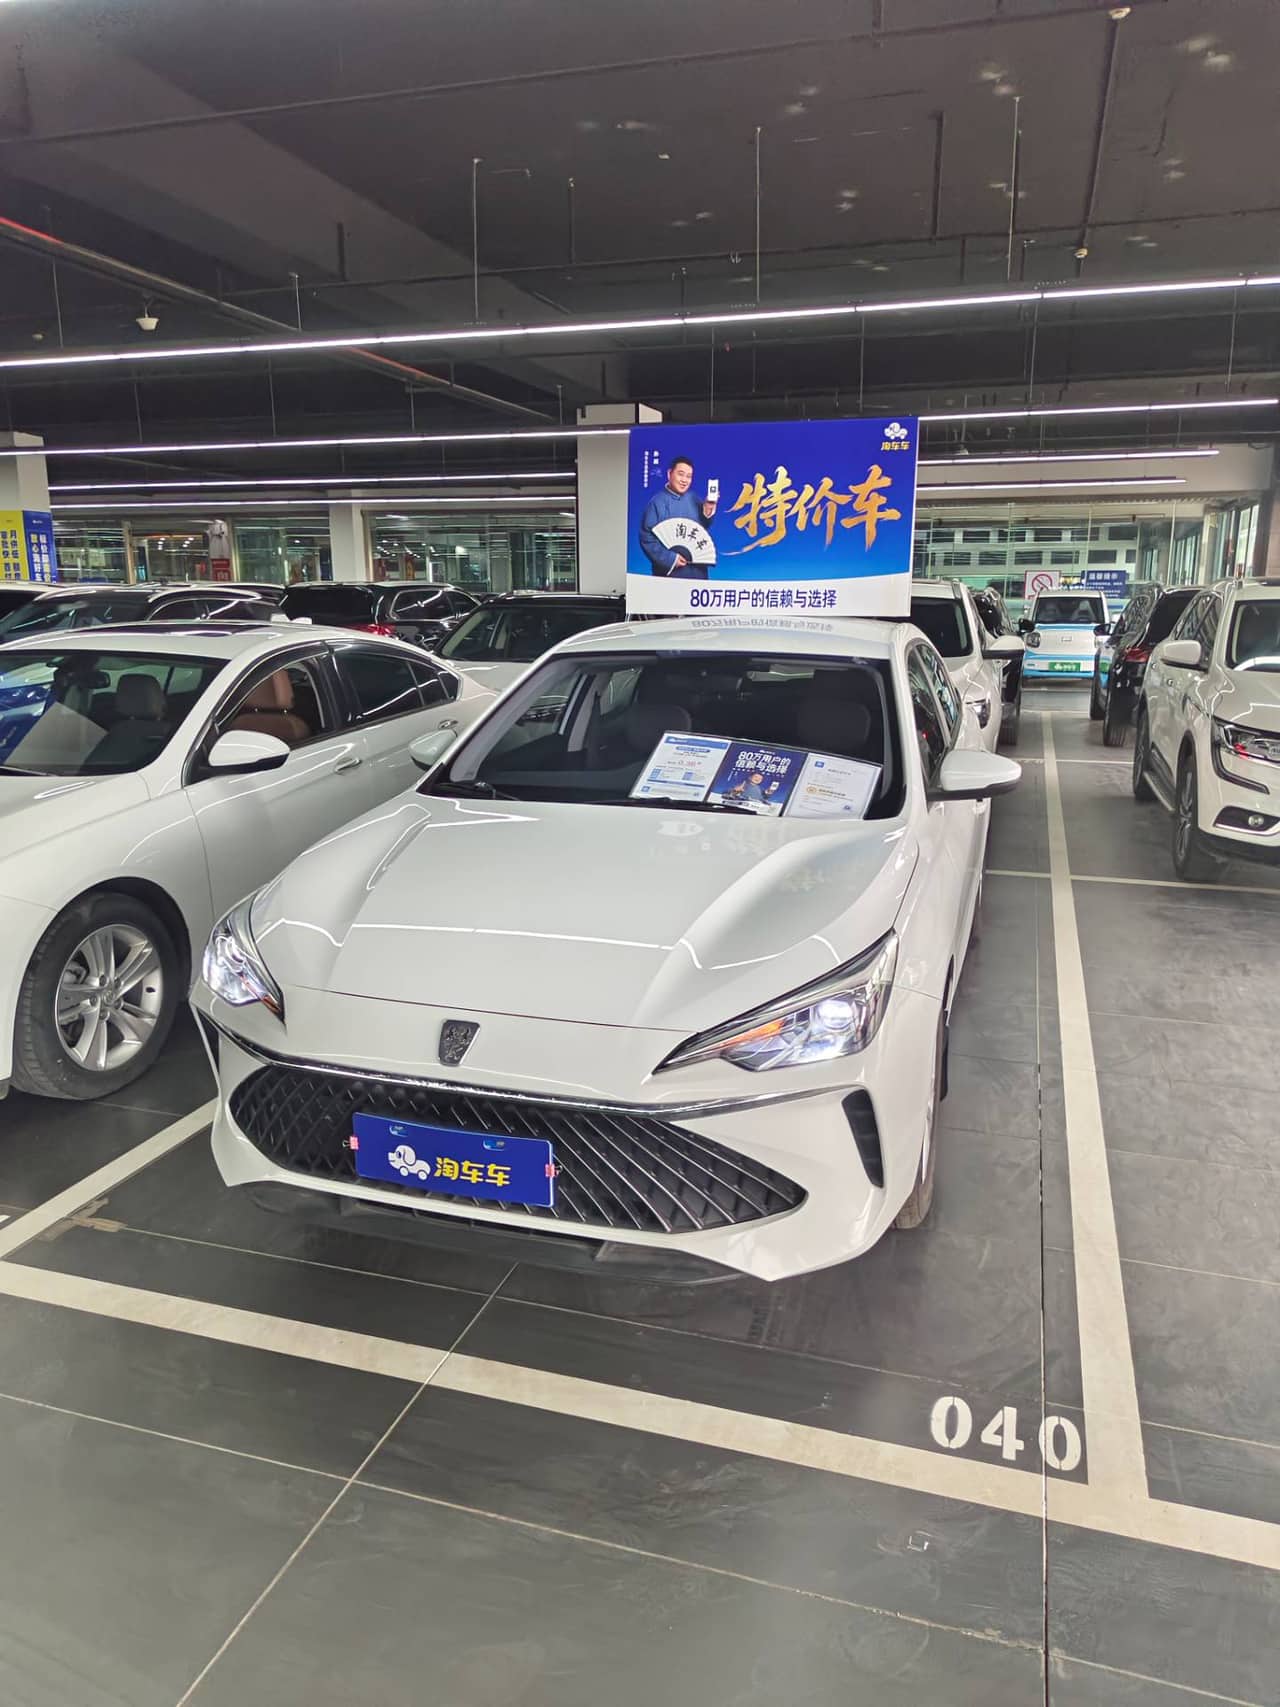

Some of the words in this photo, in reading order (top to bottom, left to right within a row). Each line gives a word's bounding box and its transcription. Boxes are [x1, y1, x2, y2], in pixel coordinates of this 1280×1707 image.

[721, 464, 902, 556] 特价车
[690, 588, 837, 608] 80万用户的信赖与选择
[433, 1156, 512, 1187] 淘车车
[930, 1395, 1082, 1471] 040
